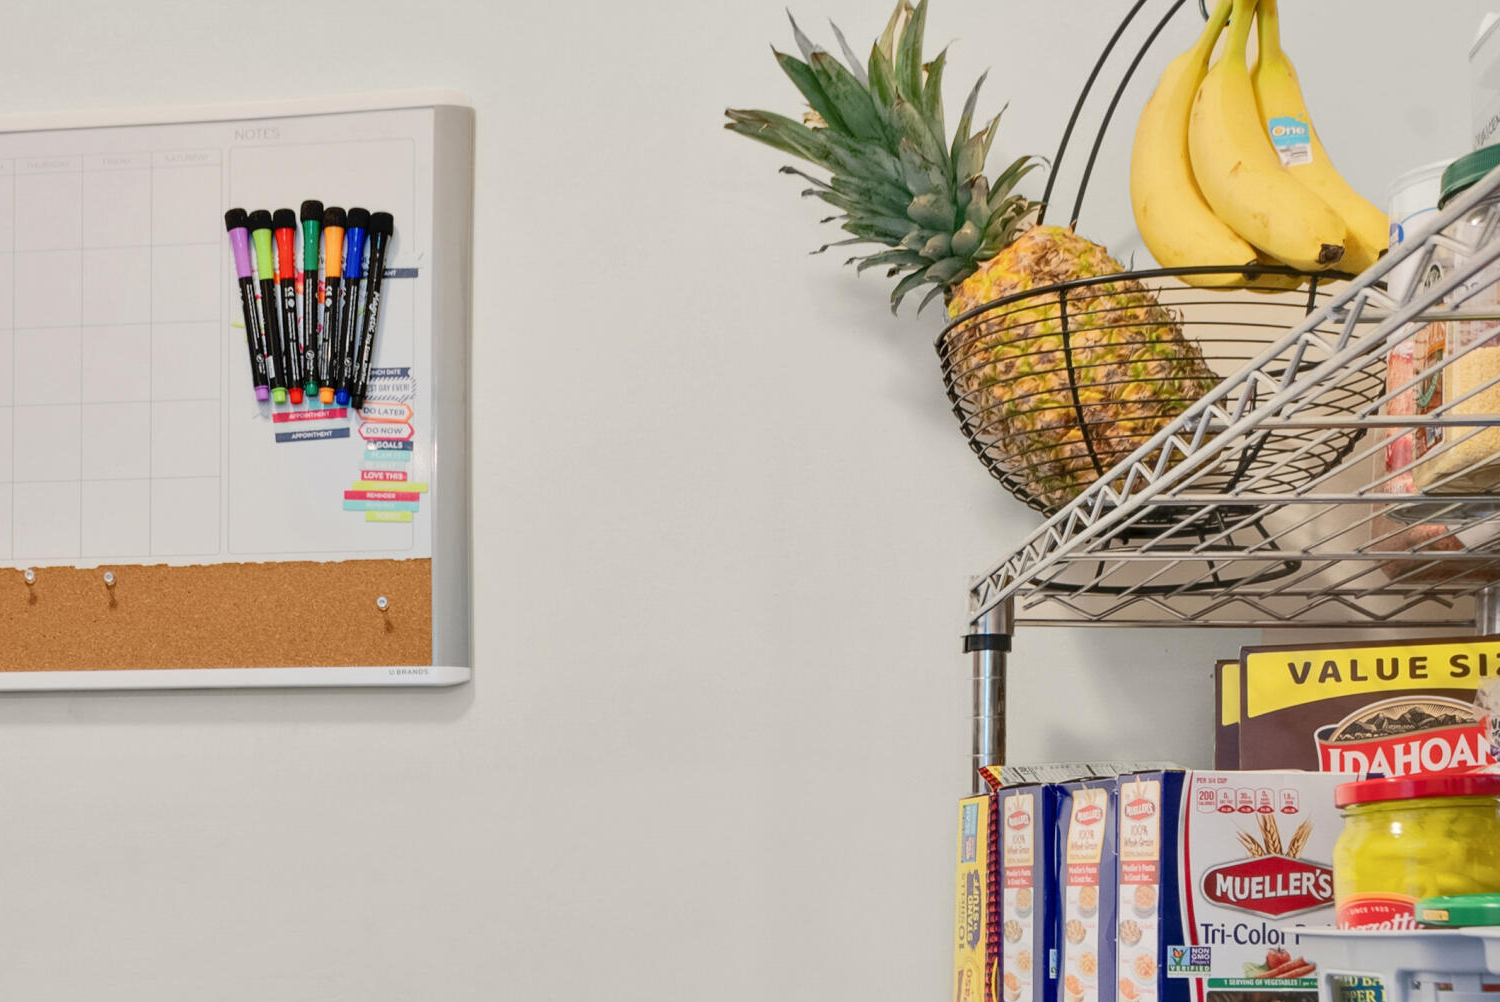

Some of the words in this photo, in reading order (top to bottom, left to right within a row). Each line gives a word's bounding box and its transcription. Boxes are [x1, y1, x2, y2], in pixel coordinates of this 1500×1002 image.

[234, 128, 280, 141] NOTES
[288, 410, 330, 420] APPOINTMENT
[363, 406, 377, 415] DO
[378, 408, 405, 416] LATER
[291, 430, 333, 440] APPOINTMENT
[366, 426, 378, 434] DO
[381, 426, 403, 434] NOW
[376, 441, 403, 450] GOALS
[363, 471, 383, 480] LOVE
[385, 472, 403, 480] THIS
[396, 668, 429, 676] BRANDS
[1287, 656, 1429, 685] VALUE
[1449, 652, 1500, 679] SI
[1199, 790, 1214, 801] 200
[1216, 868, 1332, 902] MUELLER'S
[1348, 908, 1369, 916] SINCE
[966, 894, 974, 942] STAND
[958, 925, 965, 951] 10
